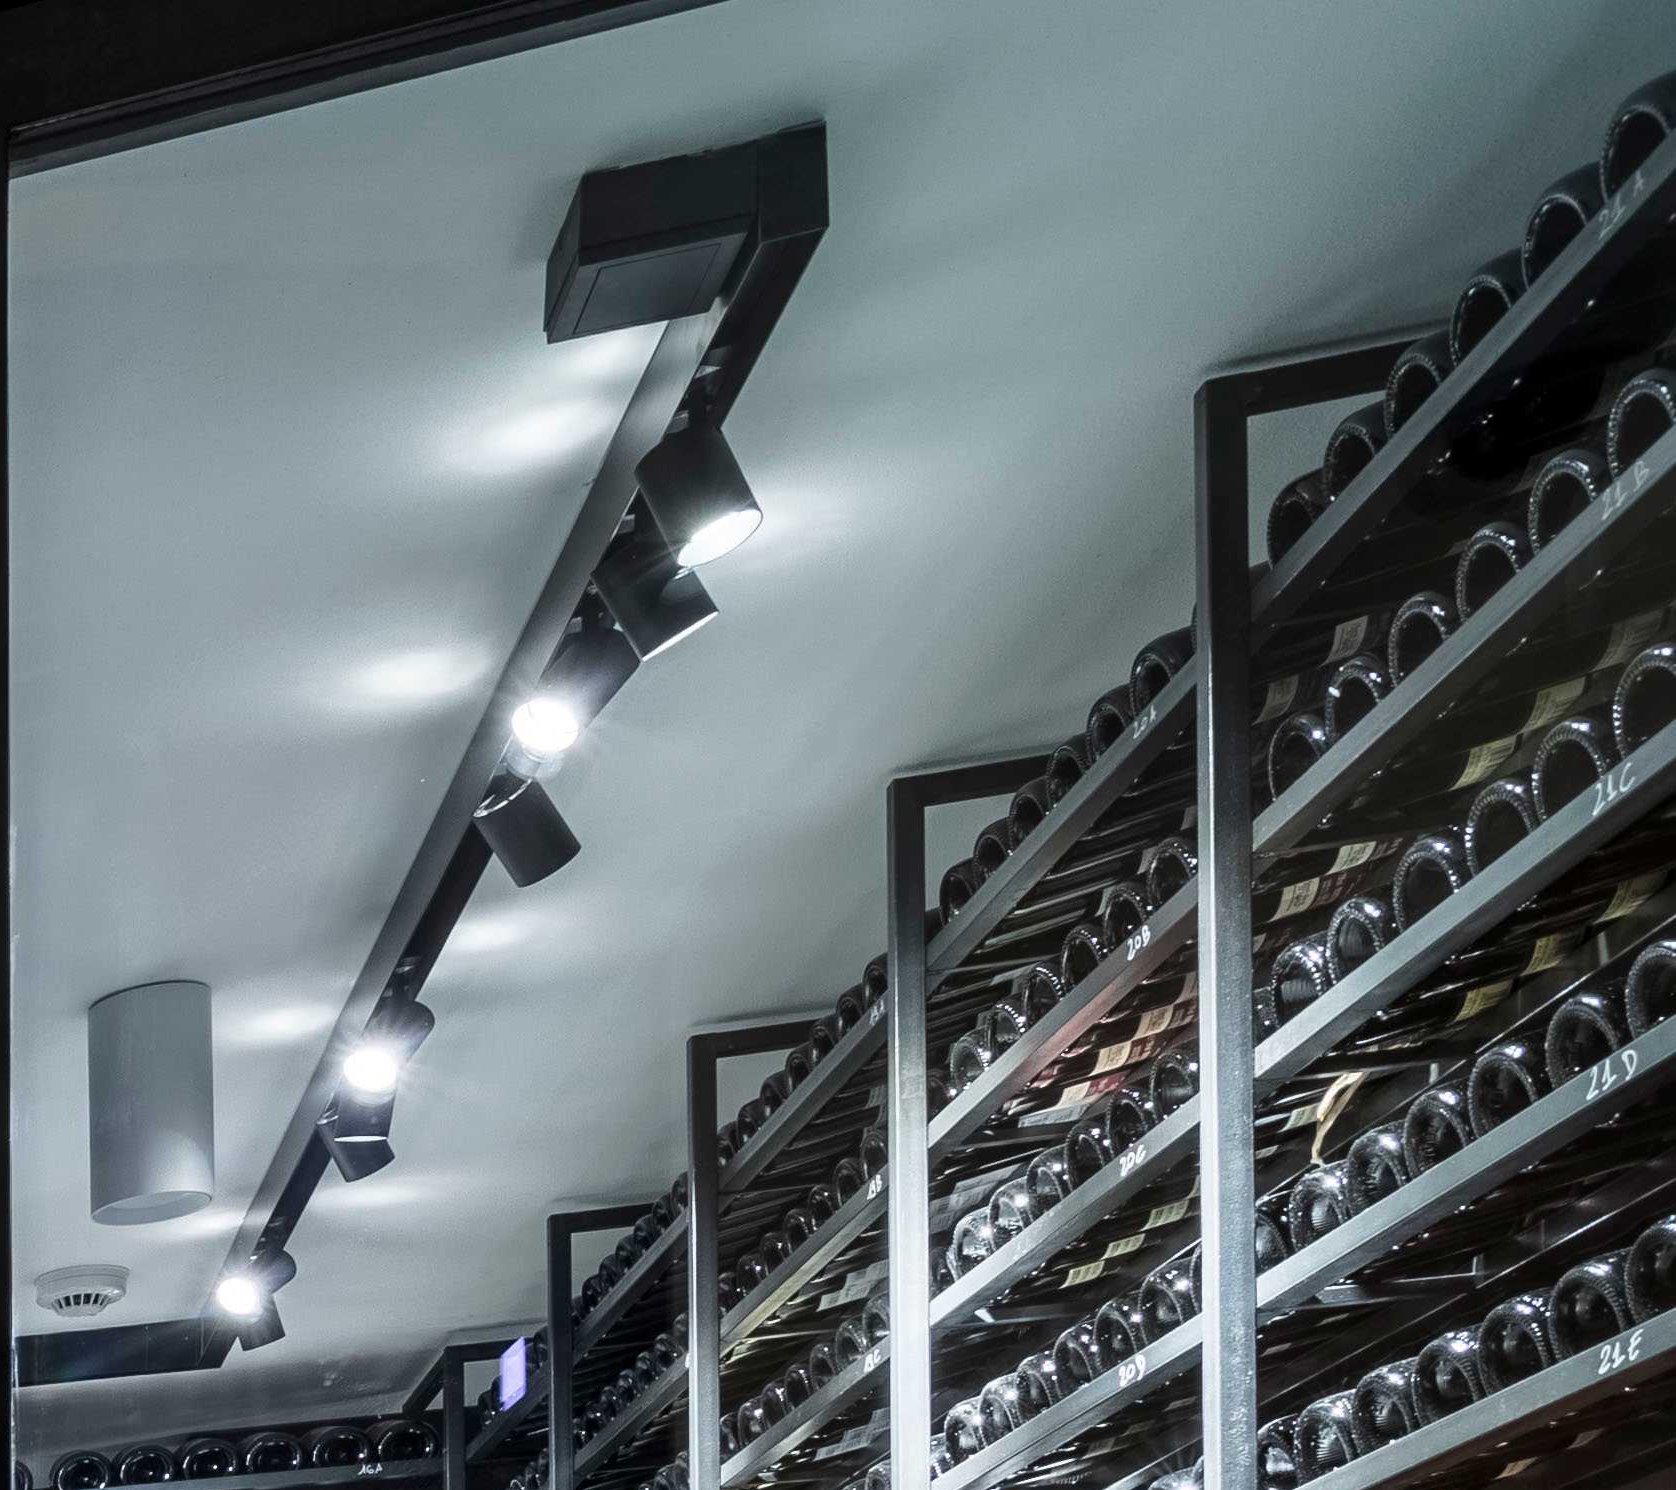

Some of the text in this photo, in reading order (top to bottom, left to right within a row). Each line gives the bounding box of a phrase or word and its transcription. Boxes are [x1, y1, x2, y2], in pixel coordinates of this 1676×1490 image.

[1126, 924, 1151, 961] 20B
[1597, 1327, 1645, 1375] 21E
[357, 1463, 383, 1475] 16A
